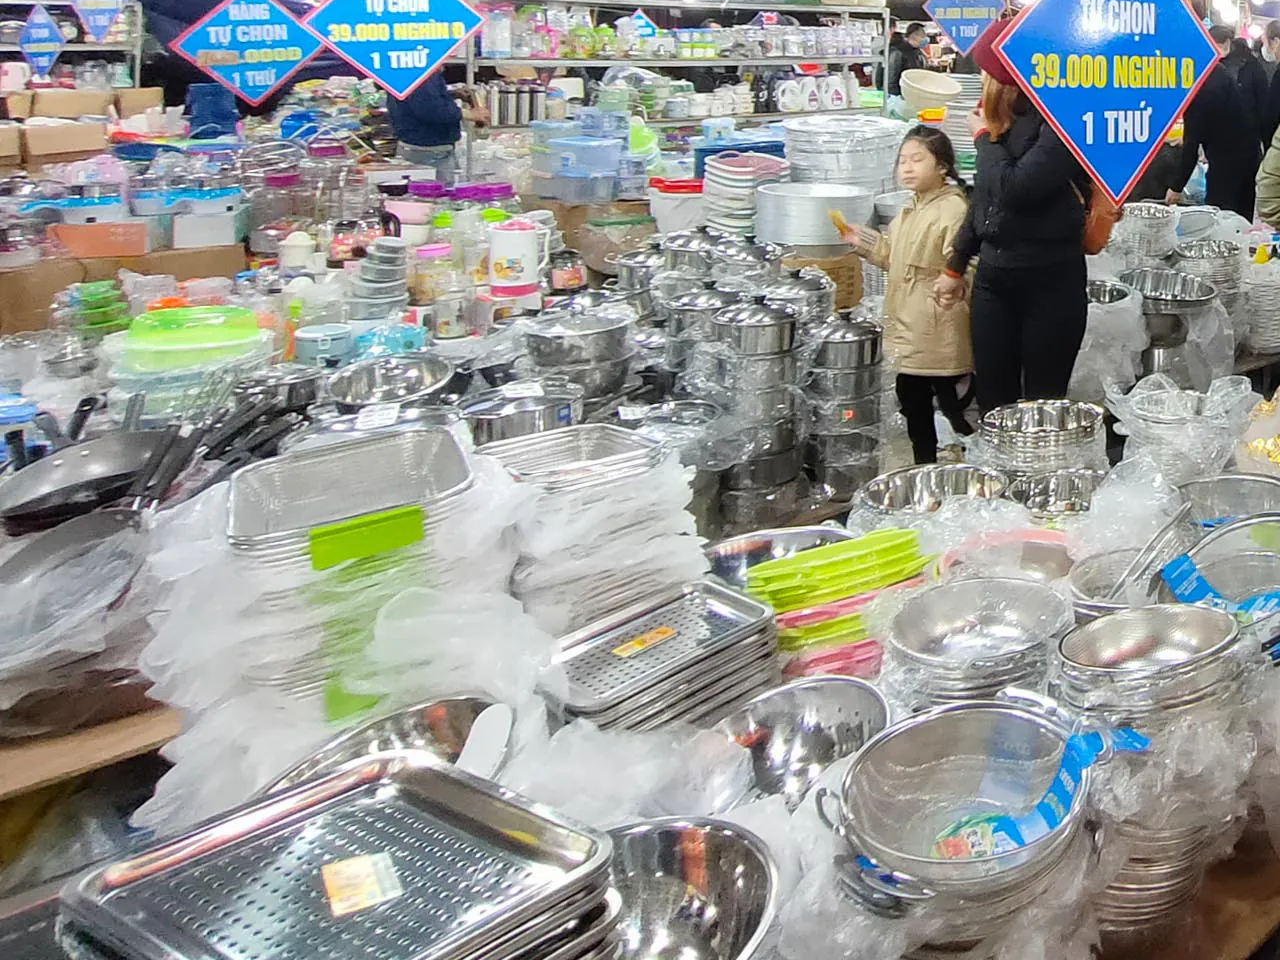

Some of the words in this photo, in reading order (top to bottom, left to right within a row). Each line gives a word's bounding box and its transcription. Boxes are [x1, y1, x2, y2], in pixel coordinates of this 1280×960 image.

[228, 0, 270, 20] HÀNG
[1108, 0, 1156, 41] CHỌN
[206, 24, 232, 46] TỰ
[235, 24, 288, 44] CHỌN
[327, 23, 390, 42] 39.000
[393, 18, 450, 41] NGHÌN
[369, 52, 381, 69] 1
[387, 45, 430, 69] THỨ
[232, 72, 240, 88] 1
[1030, 53, 1107, 88] 39.000
[1113, 50, 1177, 89] NGHÌN
[1082, 111, 1094, 144] 1
[1104, 101, 1153, 144] THỨ
